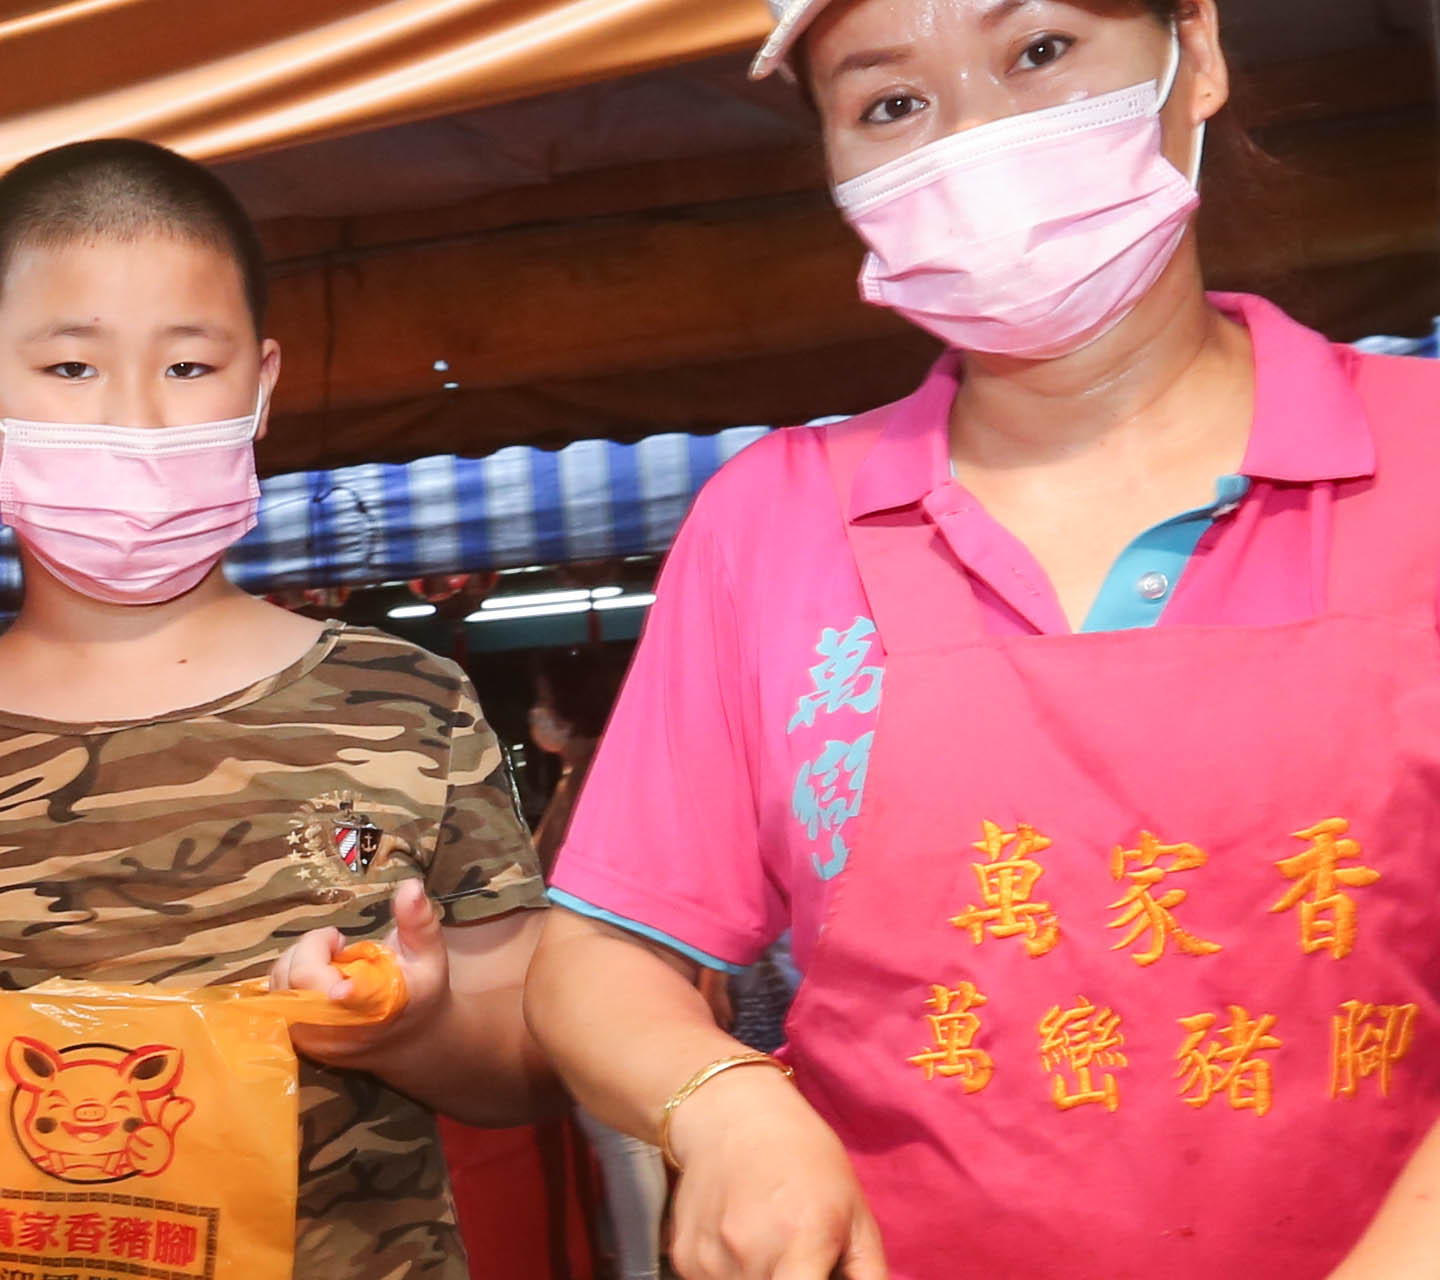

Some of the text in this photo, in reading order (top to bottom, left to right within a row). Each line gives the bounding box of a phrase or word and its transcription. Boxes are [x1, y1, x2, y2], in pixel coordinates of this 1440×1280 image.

[950, 816, 1380, 968] 萬家香
[908, 980, 1418, 1118] 萬巒豬腳
